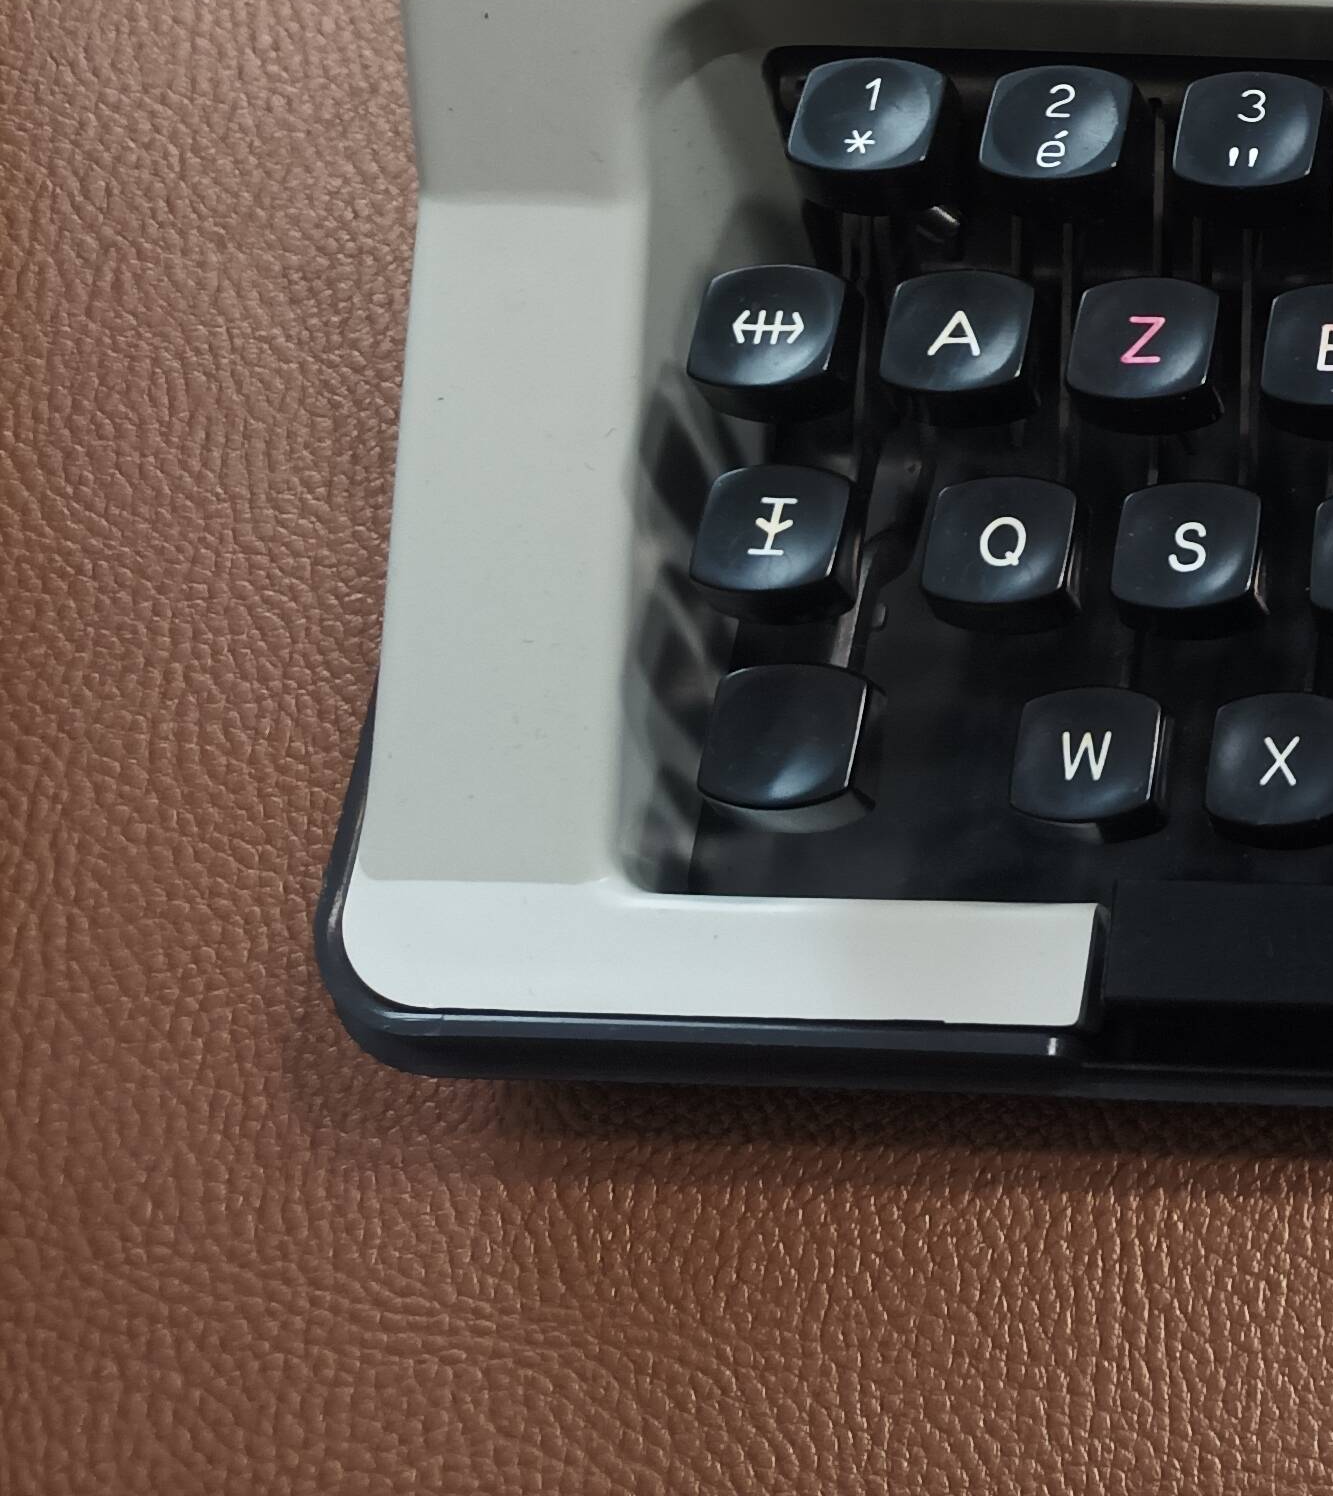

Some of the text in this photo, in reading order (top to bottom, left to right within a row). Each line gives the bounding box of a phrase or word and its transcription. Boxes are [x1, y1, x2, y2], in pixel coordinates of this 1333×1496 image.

[865, 77, 882, 111] 1
[1045, 83, 1076, 118] 2
[1237, 89, 1266, 123] 3
[1036, 129, 1069, 168] é
[926, 309, 981, 357] A
[1120, 316, 1166, 364] Z
[979, 516, 1027, 567] Q
[1168, 521, 1207, 573] S
[1062, 731, 1112, 781] W
[1259, 736, 1300, 786] X
